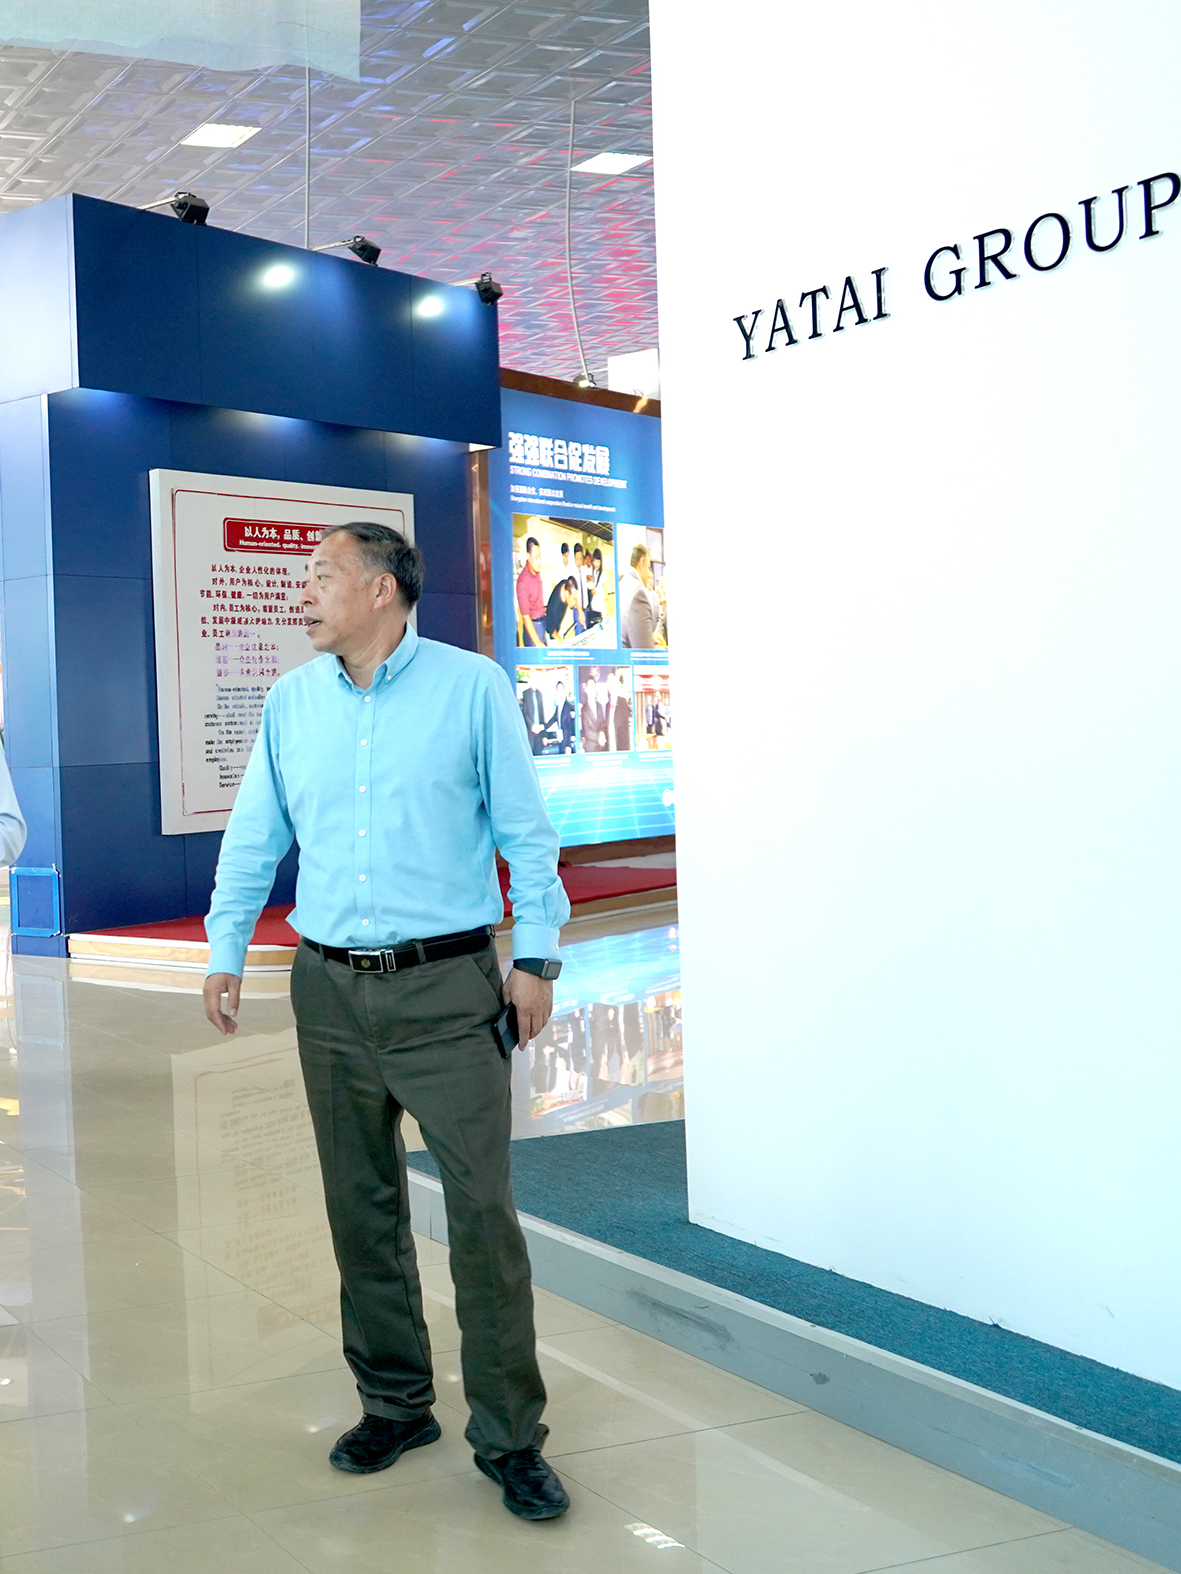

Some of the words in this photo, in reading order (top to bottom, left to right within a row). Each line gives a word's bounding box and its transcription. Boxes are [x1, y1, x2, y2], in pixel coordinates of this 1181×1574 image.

[733, 267, 891, 361] YATAI
[924, 171, 1181, 302] GROUP
[508, 431, 611, 476] 强强联合促发展
[509, 465, 532, 478] STRONG
[532, 468, 567, 482] COMBINATION
[567, 473, 593, 485] PROMOTES
[593, 476, 627, 489] DEVELOPMENT
